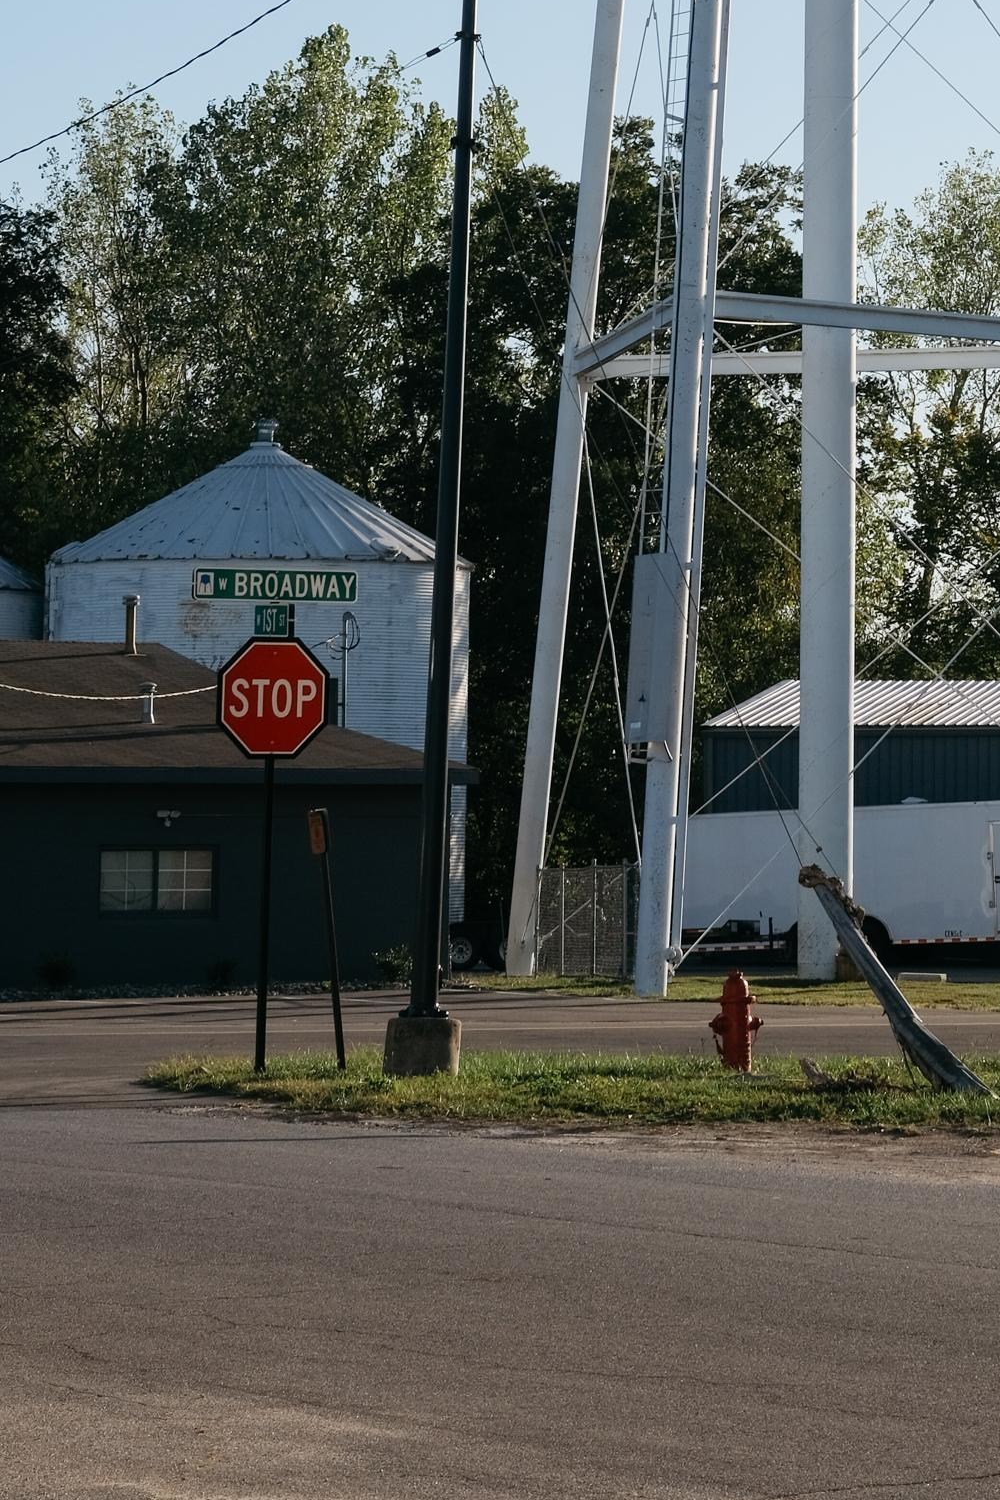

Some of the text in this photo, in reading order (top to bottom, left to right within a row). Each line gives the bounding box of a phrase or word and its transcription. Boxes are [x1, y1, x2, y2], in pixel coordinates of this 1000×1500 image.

[219, 572, 355, 599] W BROADWAY
[263, 609, 277, 632] 1ST
[229, 678, 317, 718] STOP
